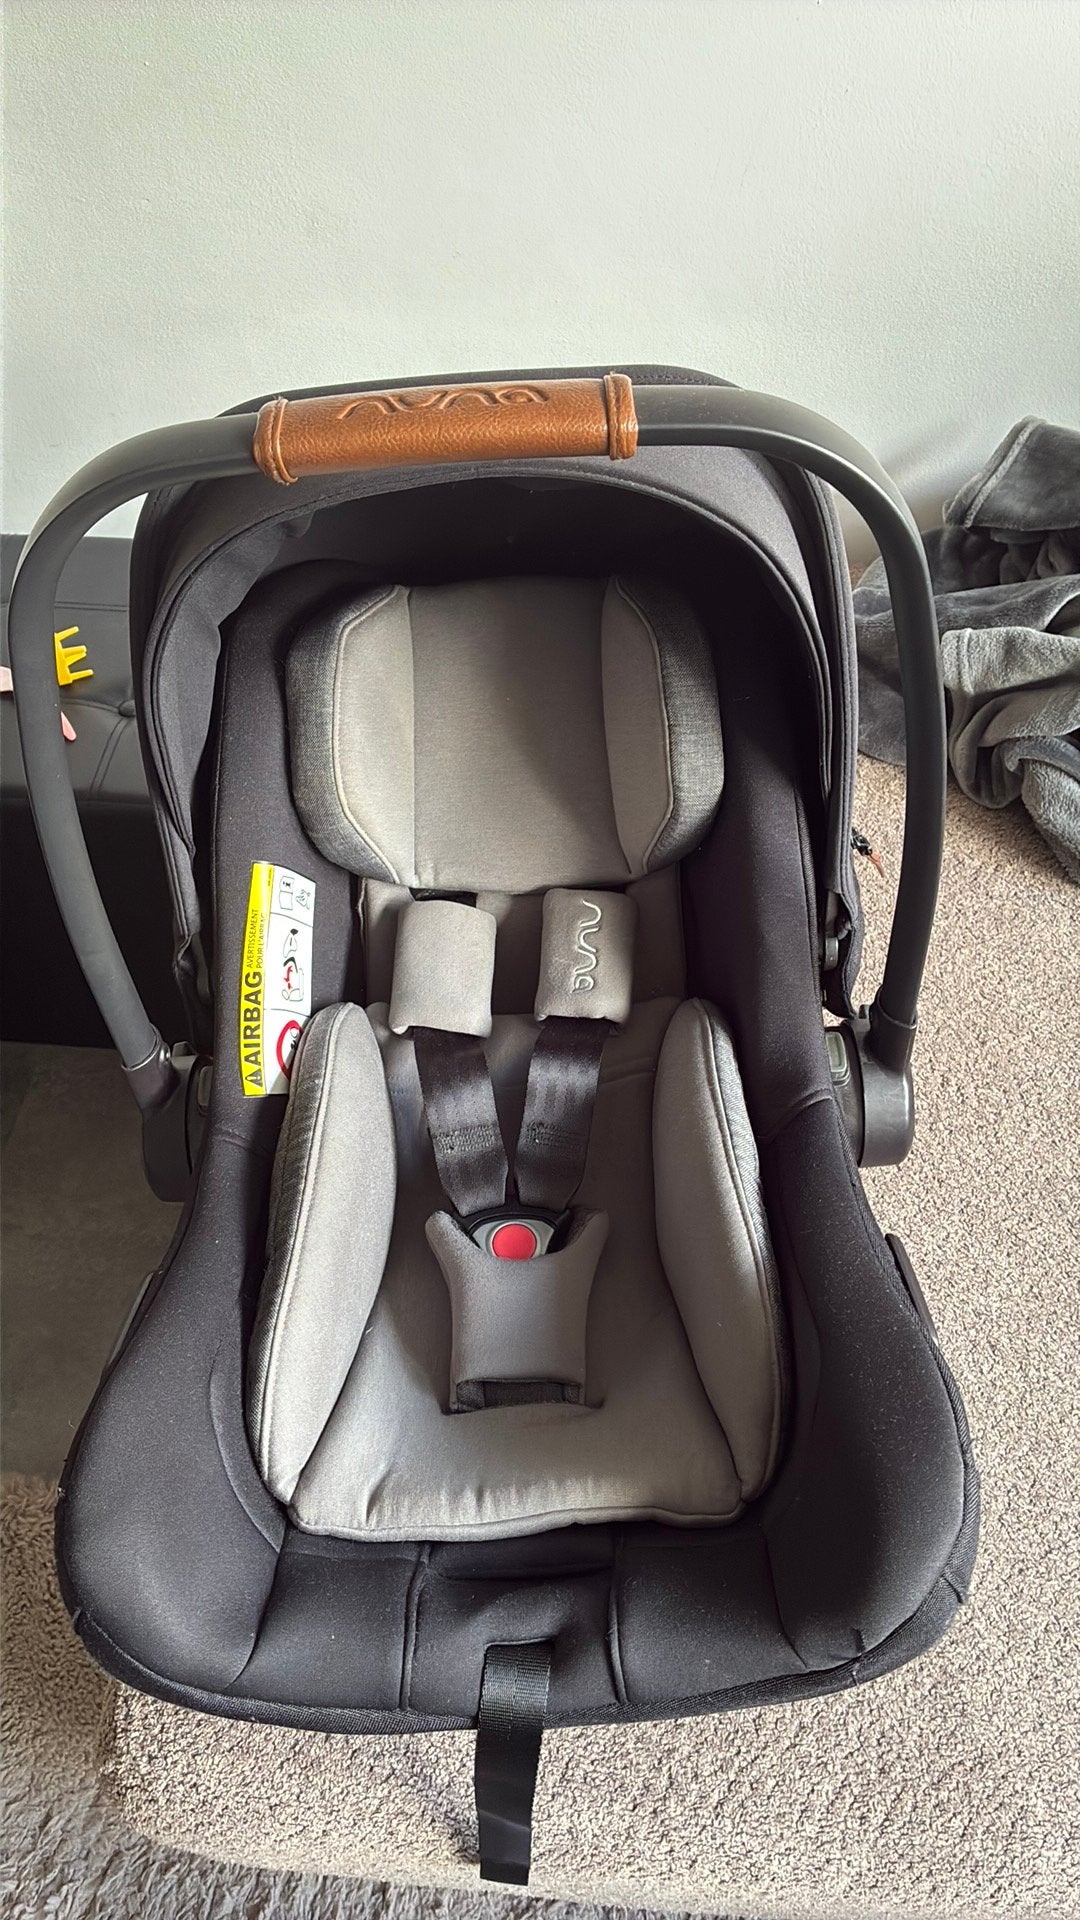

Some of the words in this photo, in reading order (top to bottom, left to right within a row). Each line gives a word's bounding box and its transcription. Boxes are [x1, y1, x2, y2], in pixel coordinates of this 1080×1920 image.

[247, 908, 258, 969] AVERTISSEMENT
[256, 947, 264, 969] POUR
[243, 971, 263, 1065] AIRBAG
